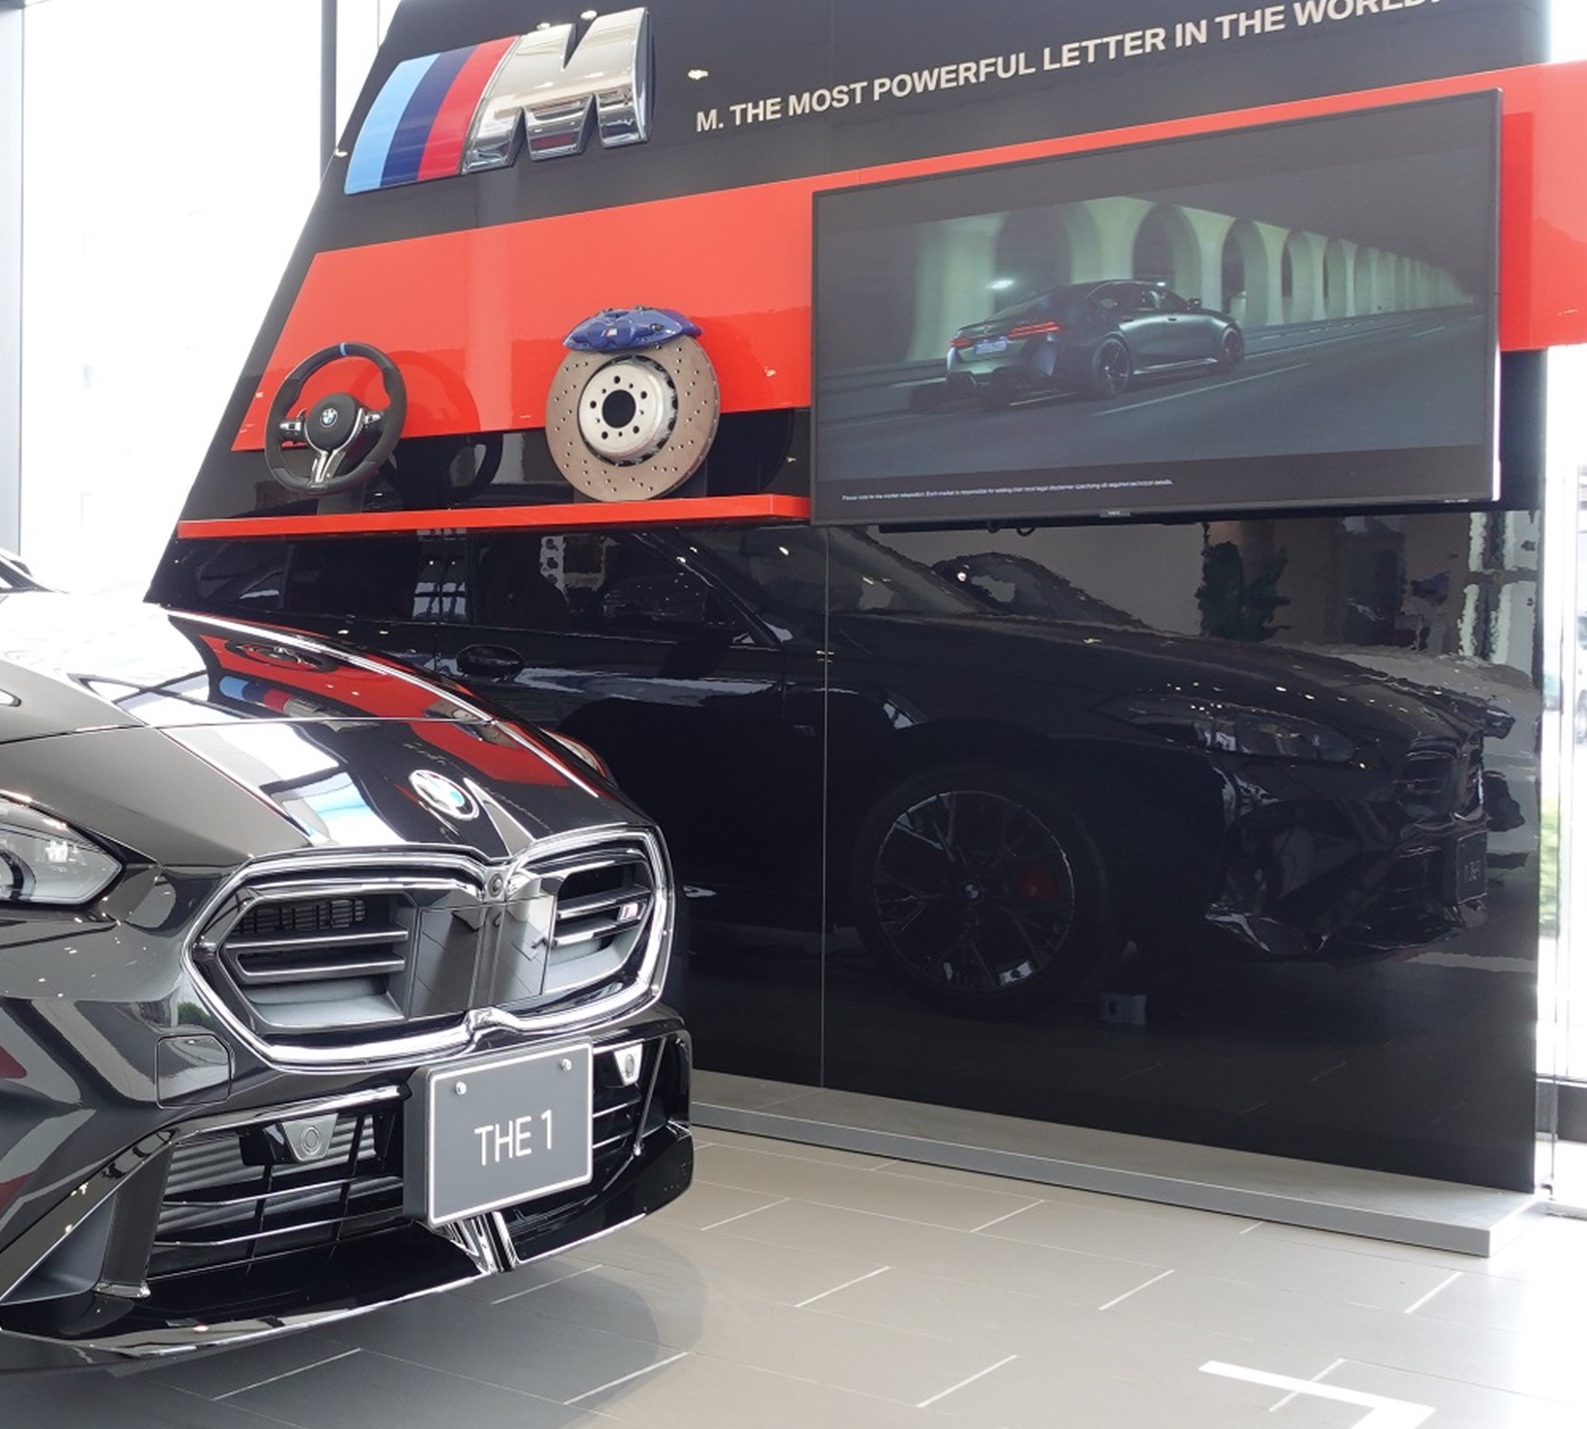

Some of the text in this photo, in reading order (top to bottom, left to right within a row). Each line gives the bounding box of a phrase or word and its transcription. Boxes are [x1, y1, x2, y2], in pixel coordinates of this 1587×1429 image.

[696, 108, 725, 133] M.
[729, 97, 783, 126] THE
[788, 82, 868, 116] MOST
[873, 52, 1037, 102] POWERFUL
[1043, 27, 1167, 70] LETTER
[1175, 19, 1208, 48] IN
[1214, 5, 1286, 40] THE
[474, 1109, 552, 1166] THE 1
